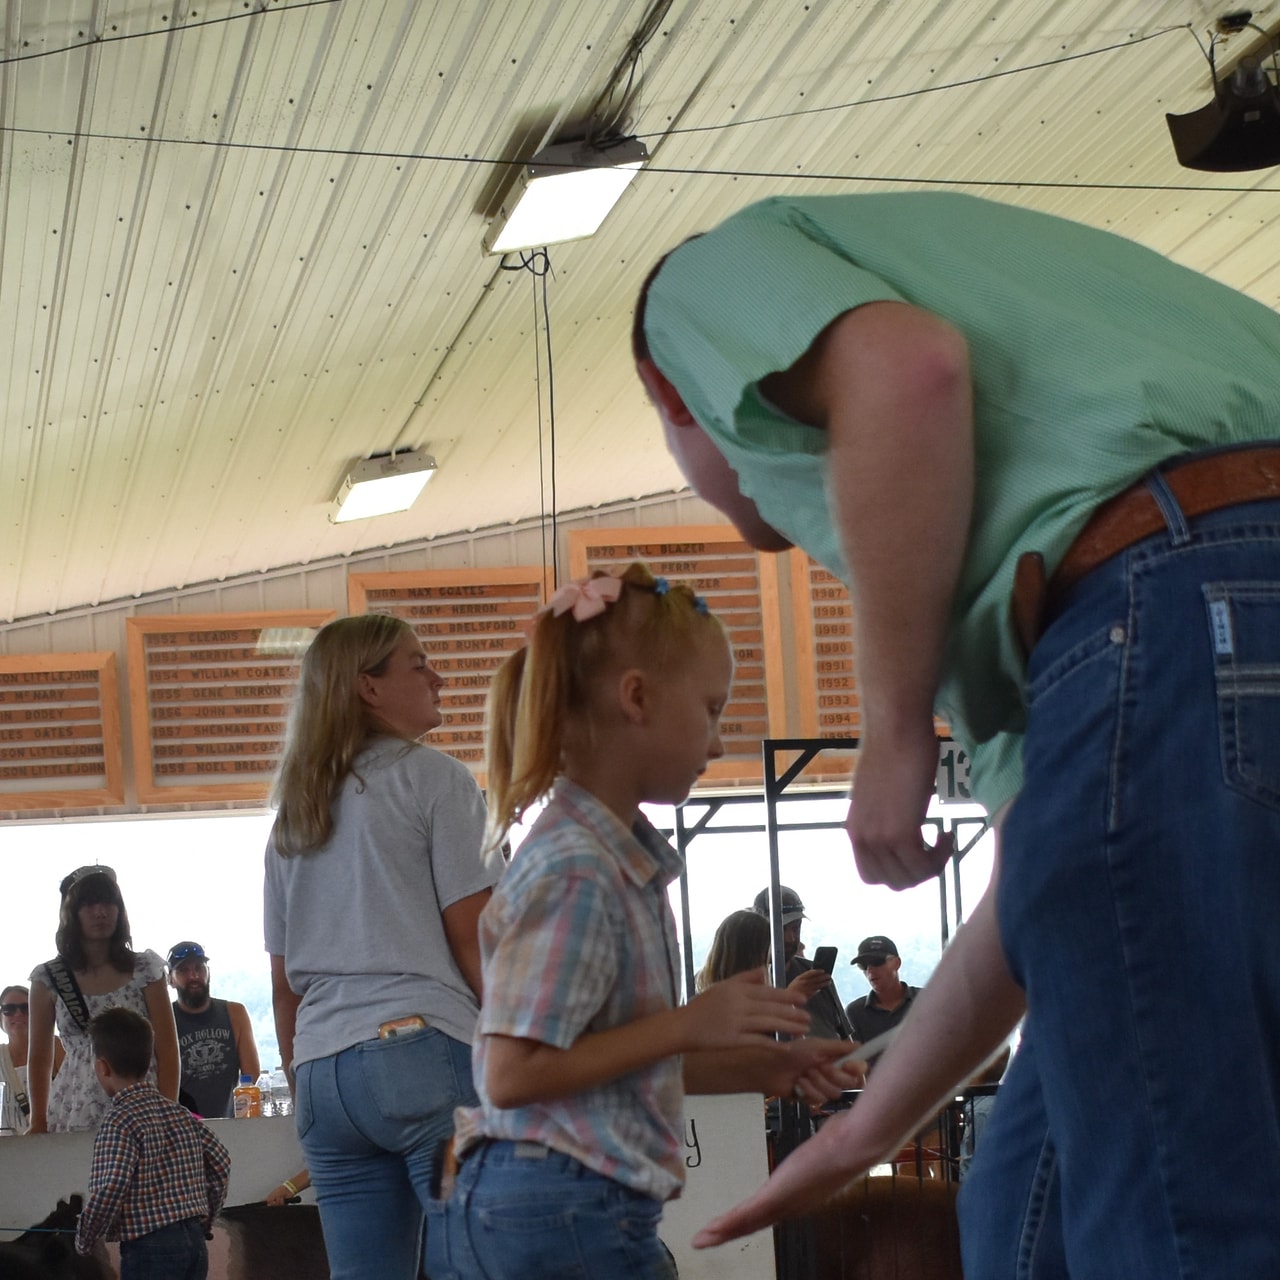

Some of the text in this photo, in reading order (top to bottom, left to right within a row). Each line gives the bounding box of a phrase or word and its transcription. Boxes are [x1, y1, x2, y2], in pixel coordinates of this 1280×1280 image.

[660, 543, 705, 554] BLAZER
[661, 562, 698, 573] PERRY
[408, 587, 432, 597] MAX
[439, 586, 485, 597] COATES
[815, 588, 842, 598] 1987
[410, 604, 498, 616] GARY HERRON
[449, 621, 517, 632] BRELSFORD
[819, 624, 846, 634] 1989
[148, 633, 177, 645] 1952
[456, 639, 505, 651] RUNYAN
[820, 643, 847, 653] 1990
[821, 661, 845, 671] 1991
[24, 670, 99, 682] LITTLEJOHN
[150, 669, 179, 681] 1954
[191, 668, 240, 680] WILLIAM
[822, 678, 849, 688] 1992
[151, 685, 281, 700] 1955 GENE HERRON
[823, 695, 850, 706] 1993
[25, 708, 65, 720] BODEY
[152, 704, 270, 719] 1956 JOHN WHITE
[824, 714, 851, 724] 1994
[153, 726, 182, 738] 1957
[193, 724, 250, 737] SHERMAN
[29, 744, 105, 758] LITTLEJOHN
[195, 743, 245, 754] WILLIAM
[31, 763, 106, 776] LITTLEJOHN
[155, 763, 186, 774] 1959
[197, 761, 227, 773] NOEL
[195, 1027, 231, 1041] HOLLOW
